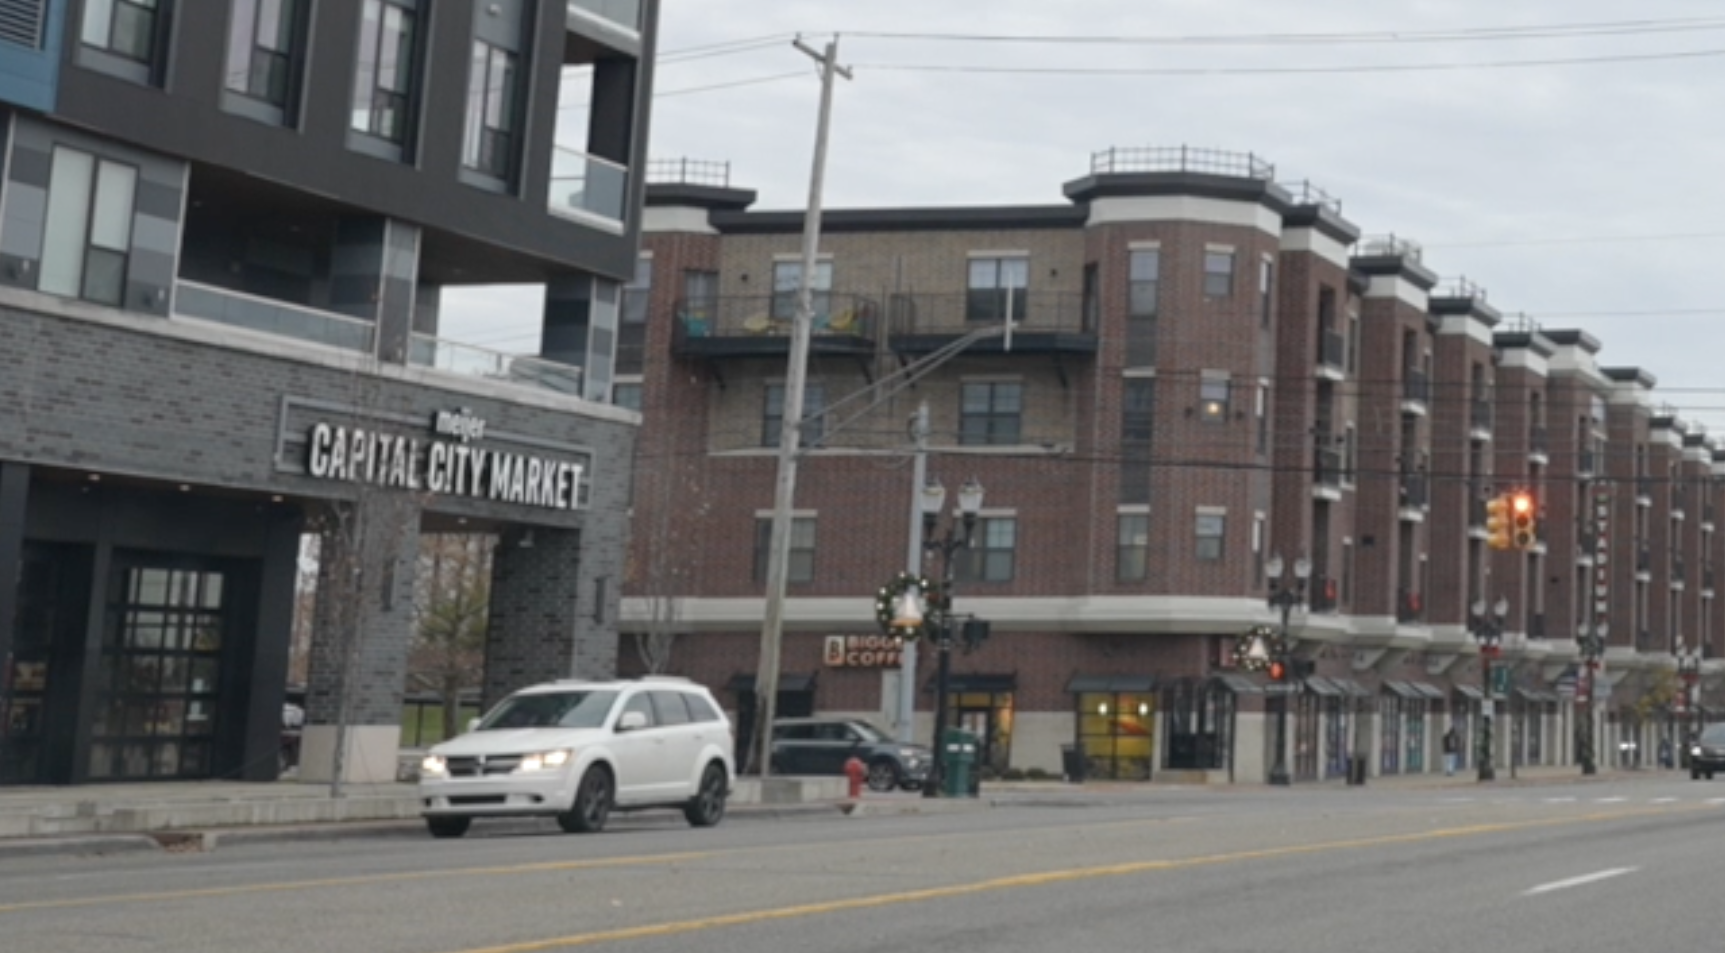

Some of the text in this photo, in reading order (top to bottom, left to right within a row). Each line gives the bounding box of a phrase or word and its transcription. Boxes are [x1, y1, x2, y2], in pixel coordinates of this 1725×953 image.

[434, 407, 487, 441] meijer
[309, 422, 584, 510] CAPITAL CITY MARKET
[847, 635, 904, 649] BIGG
[847, 651, 905, 666] COFF
